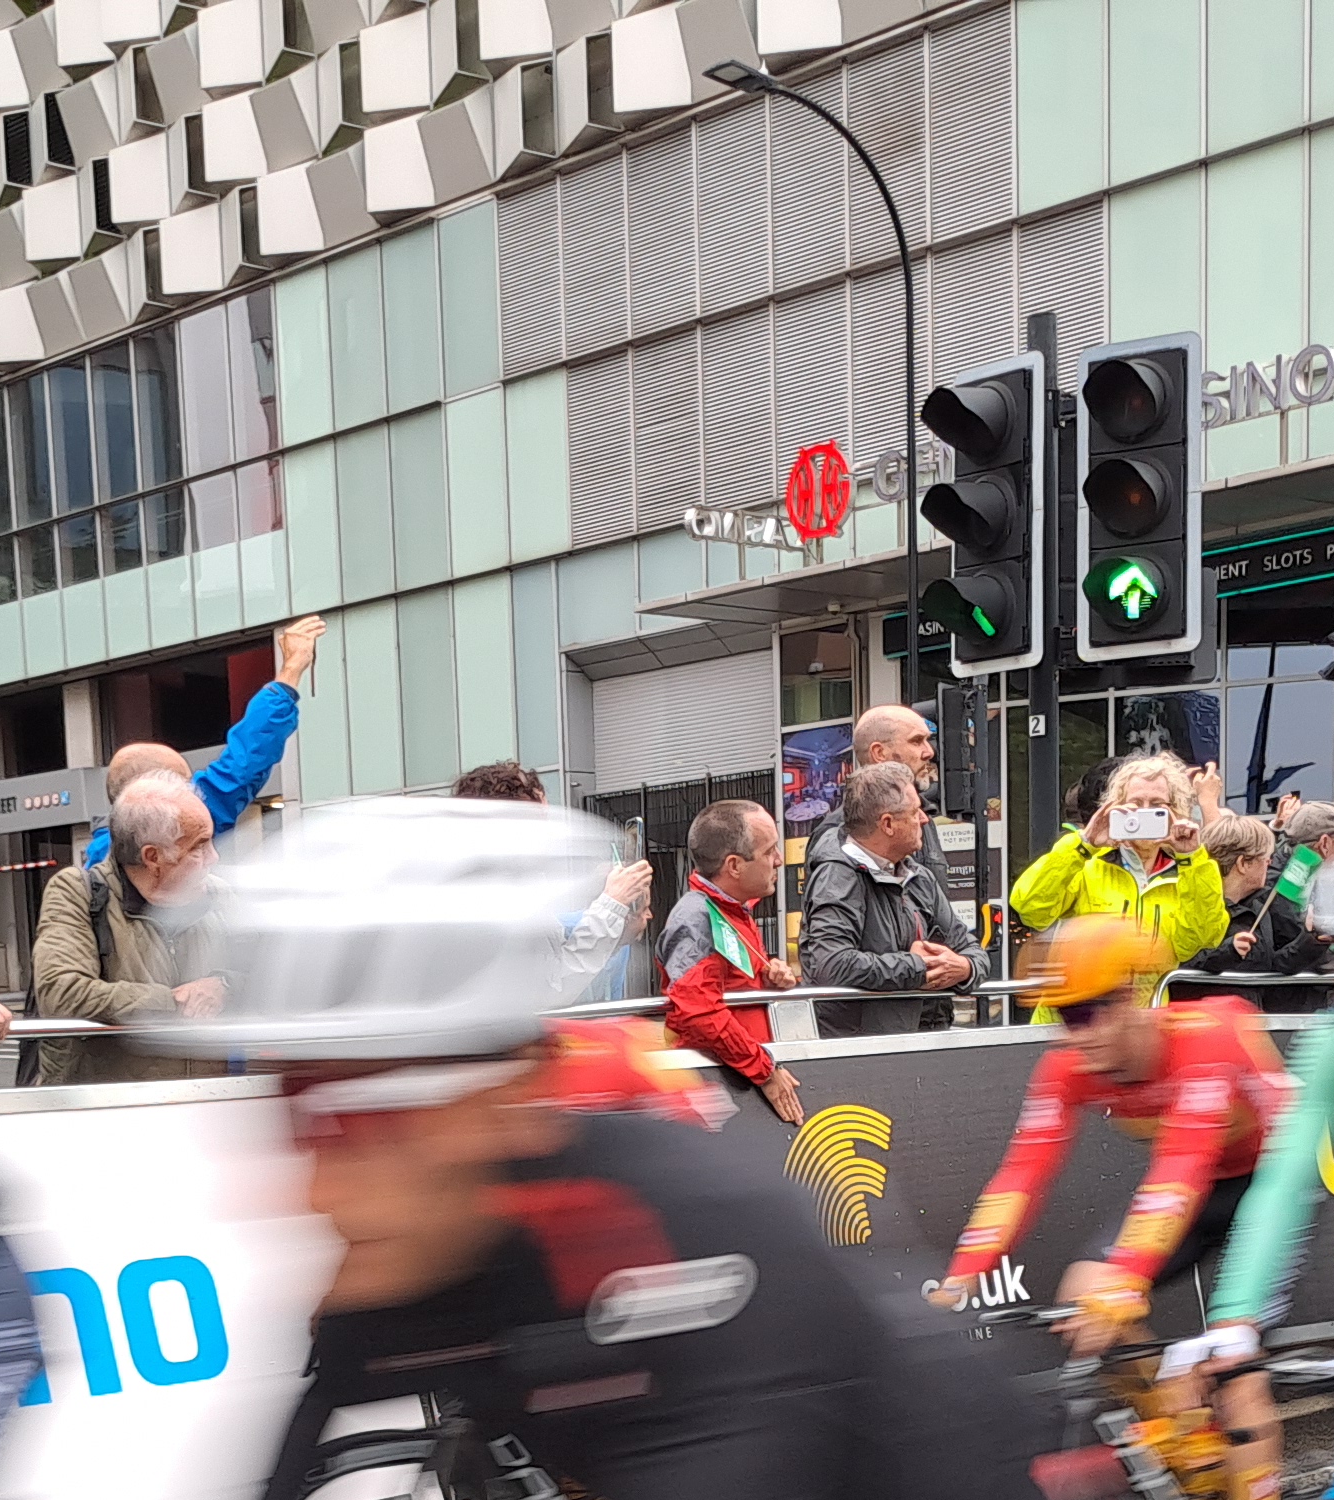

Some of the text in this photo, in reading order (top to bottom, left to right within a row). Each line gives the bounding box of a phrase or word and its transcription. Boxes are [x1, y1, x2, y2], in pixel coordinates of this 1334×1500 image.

[1263, 548, 1313, 572] SLOTS
[918, 620, 945, 636] ASIN
[1031, 716, 1041, 734] 2
